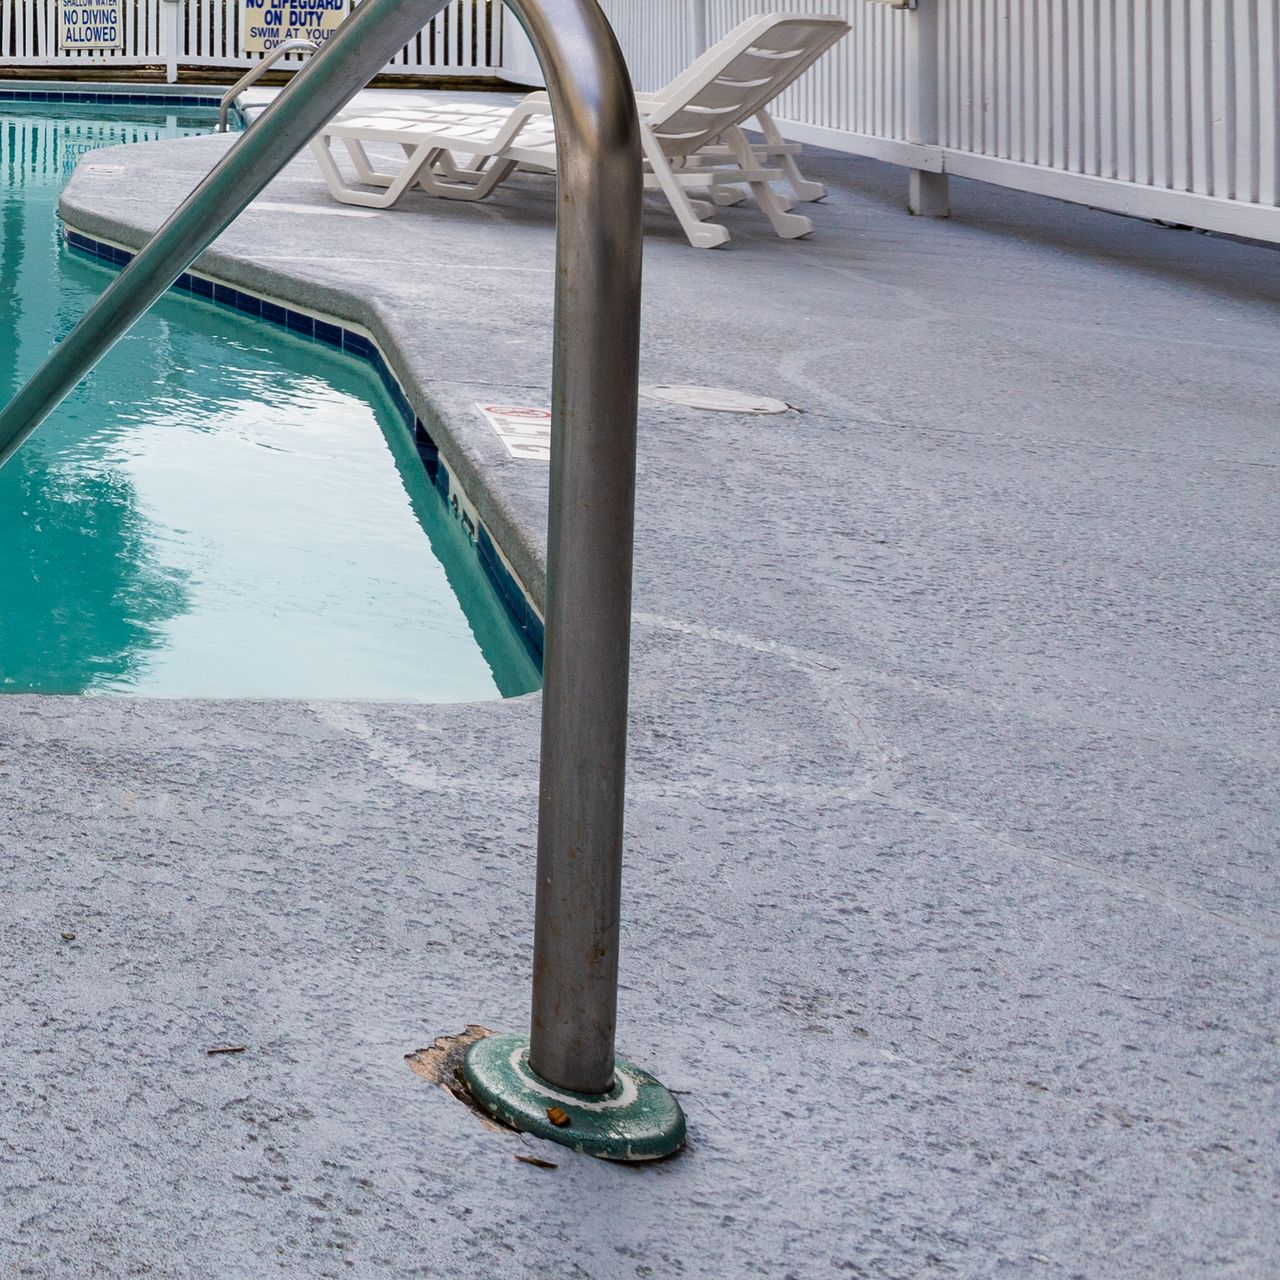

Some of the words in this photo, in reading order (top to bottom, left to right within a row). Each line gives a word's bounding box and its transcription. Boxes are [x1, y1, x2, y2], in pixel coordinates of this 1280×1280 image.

[64, 9, 79, 25] NO
[82, 8, 118, 25] DIVING
[264, 10, 283, 26] ON
[289, 11, 324, 27] DUTY
[65, 26, 117, 42] ALLOWED
[250, 26, 280, 38] SWIM
[285, 28, 300, 39] AT
